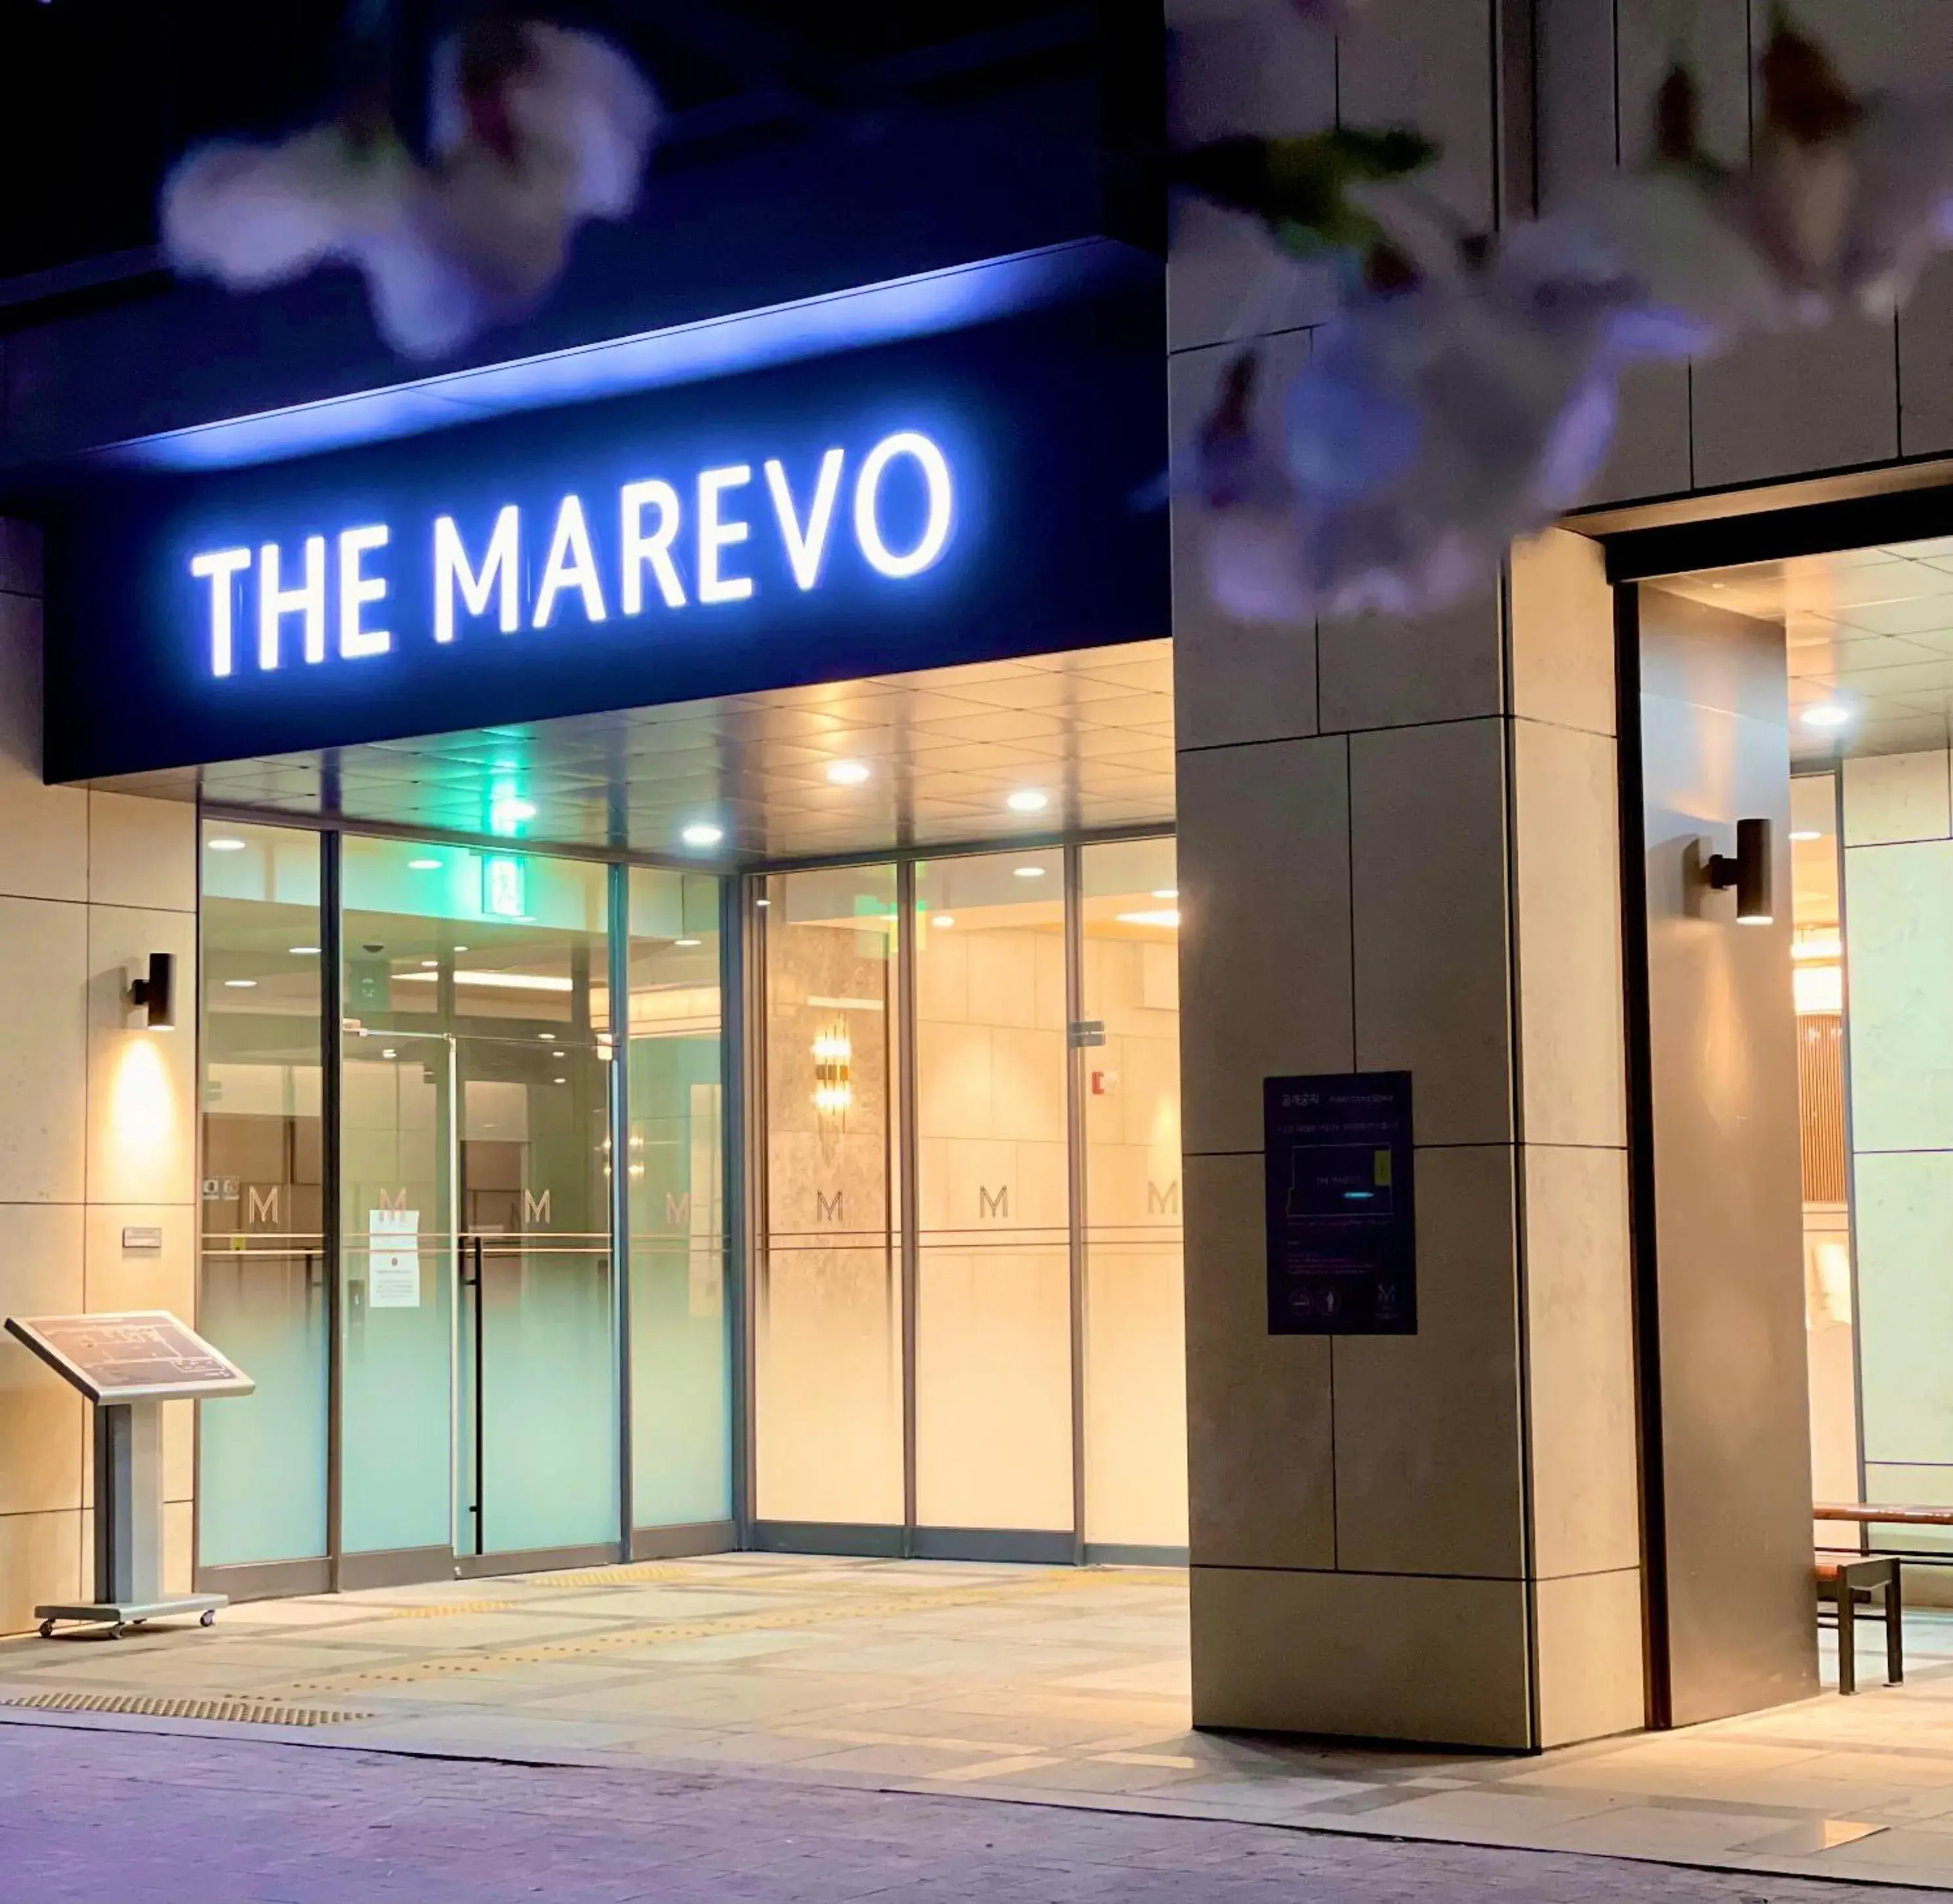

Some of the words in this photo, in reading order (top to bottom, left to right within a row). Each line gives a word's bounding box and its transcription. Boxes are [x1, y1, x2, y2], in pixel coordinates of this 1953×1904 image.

[193, 526, 389, 675] THE
[436, 433, 950, 641] MAREVO
[249, 1186, 279, 1224] M
[379, 1187, 407, 1222] M
[525, 1189, 550, 1224] M
[817, 1189, 843, 1222] M
[980, 1184, 1008, 1218] M
[1148, 1180, 1178, 1214] M
